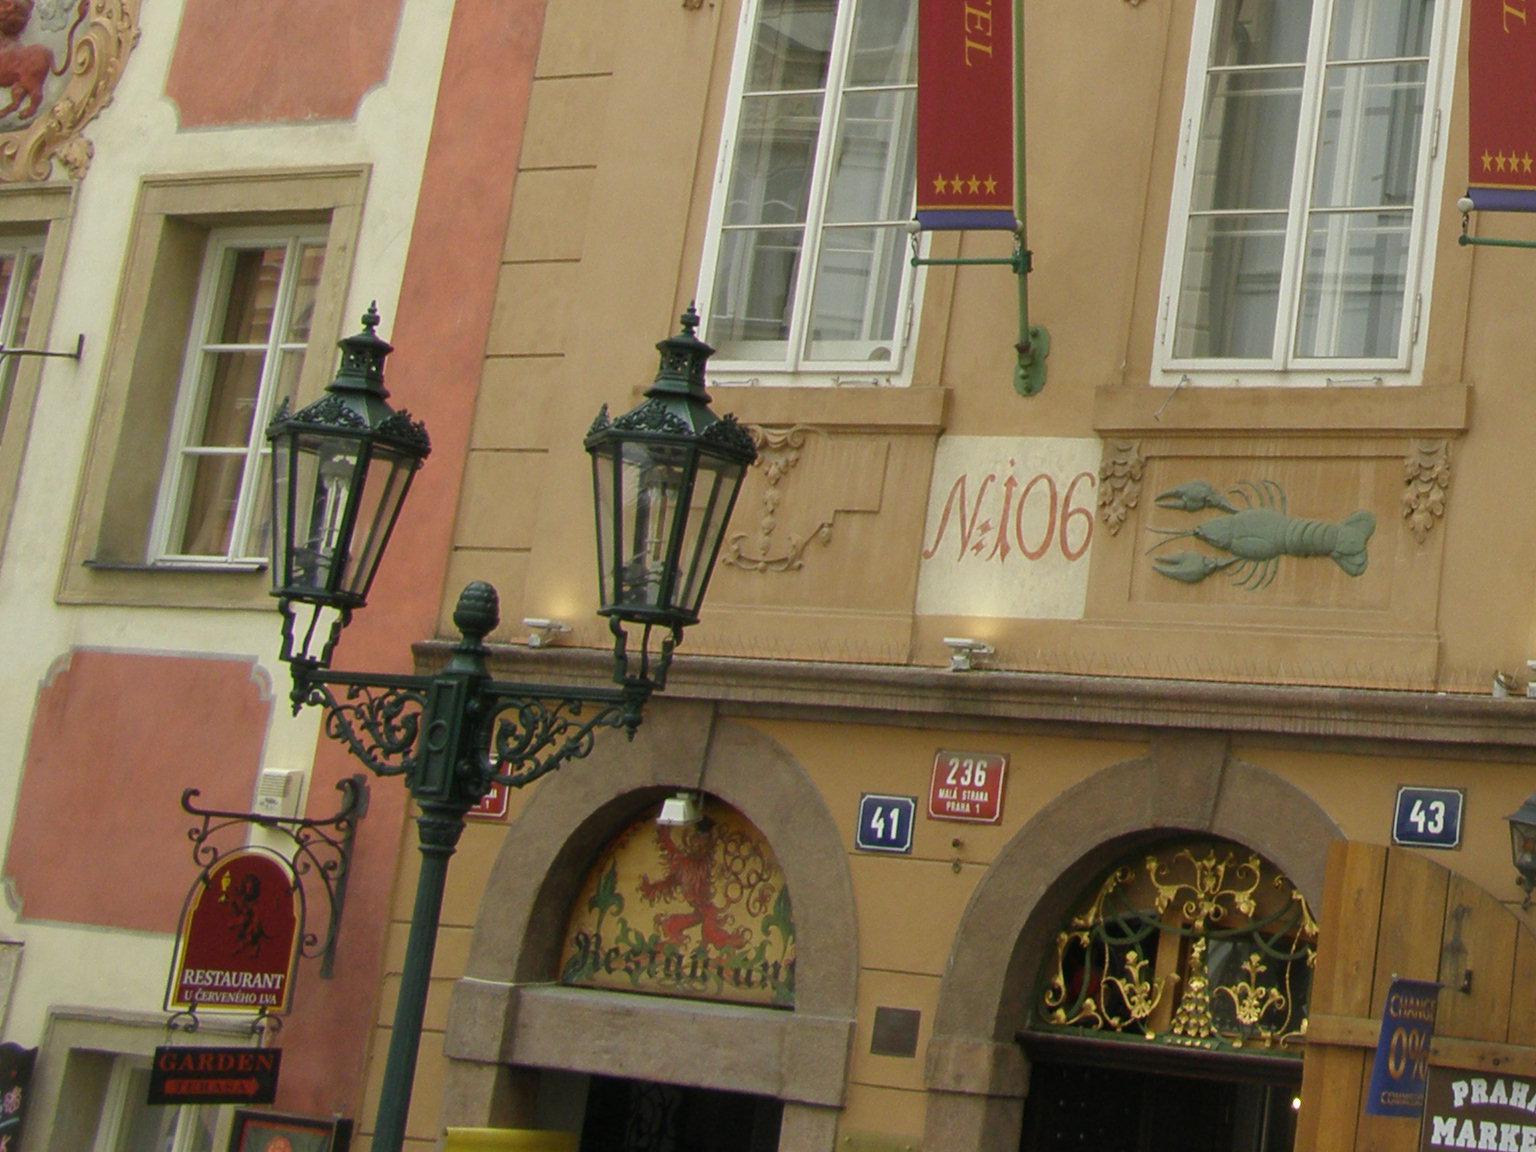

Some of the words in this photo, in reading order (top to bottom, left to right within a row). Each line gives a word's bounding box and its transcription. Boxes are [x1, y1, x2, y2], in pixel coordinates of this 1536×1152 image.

[946, 758, 988, 787] 236
[939, 786, 957, 799] MALÁ
[962, 790, 988, 802] STRANA
[946, 802, 970, 814] PRAHA
[975, 803, 981, 814] 1
[1409, 799, 1446, 835] 43
[871, 806, 900, 840] 41
[182, 969, 285, 989] RESTAURANT
[184, 990, 192, 1001] U
[194, 988, 256, 1004] ČERVENÉHO
[259, 993, 277, 1004] LVA
[159, 1052, 274, 1072] GARDEN
